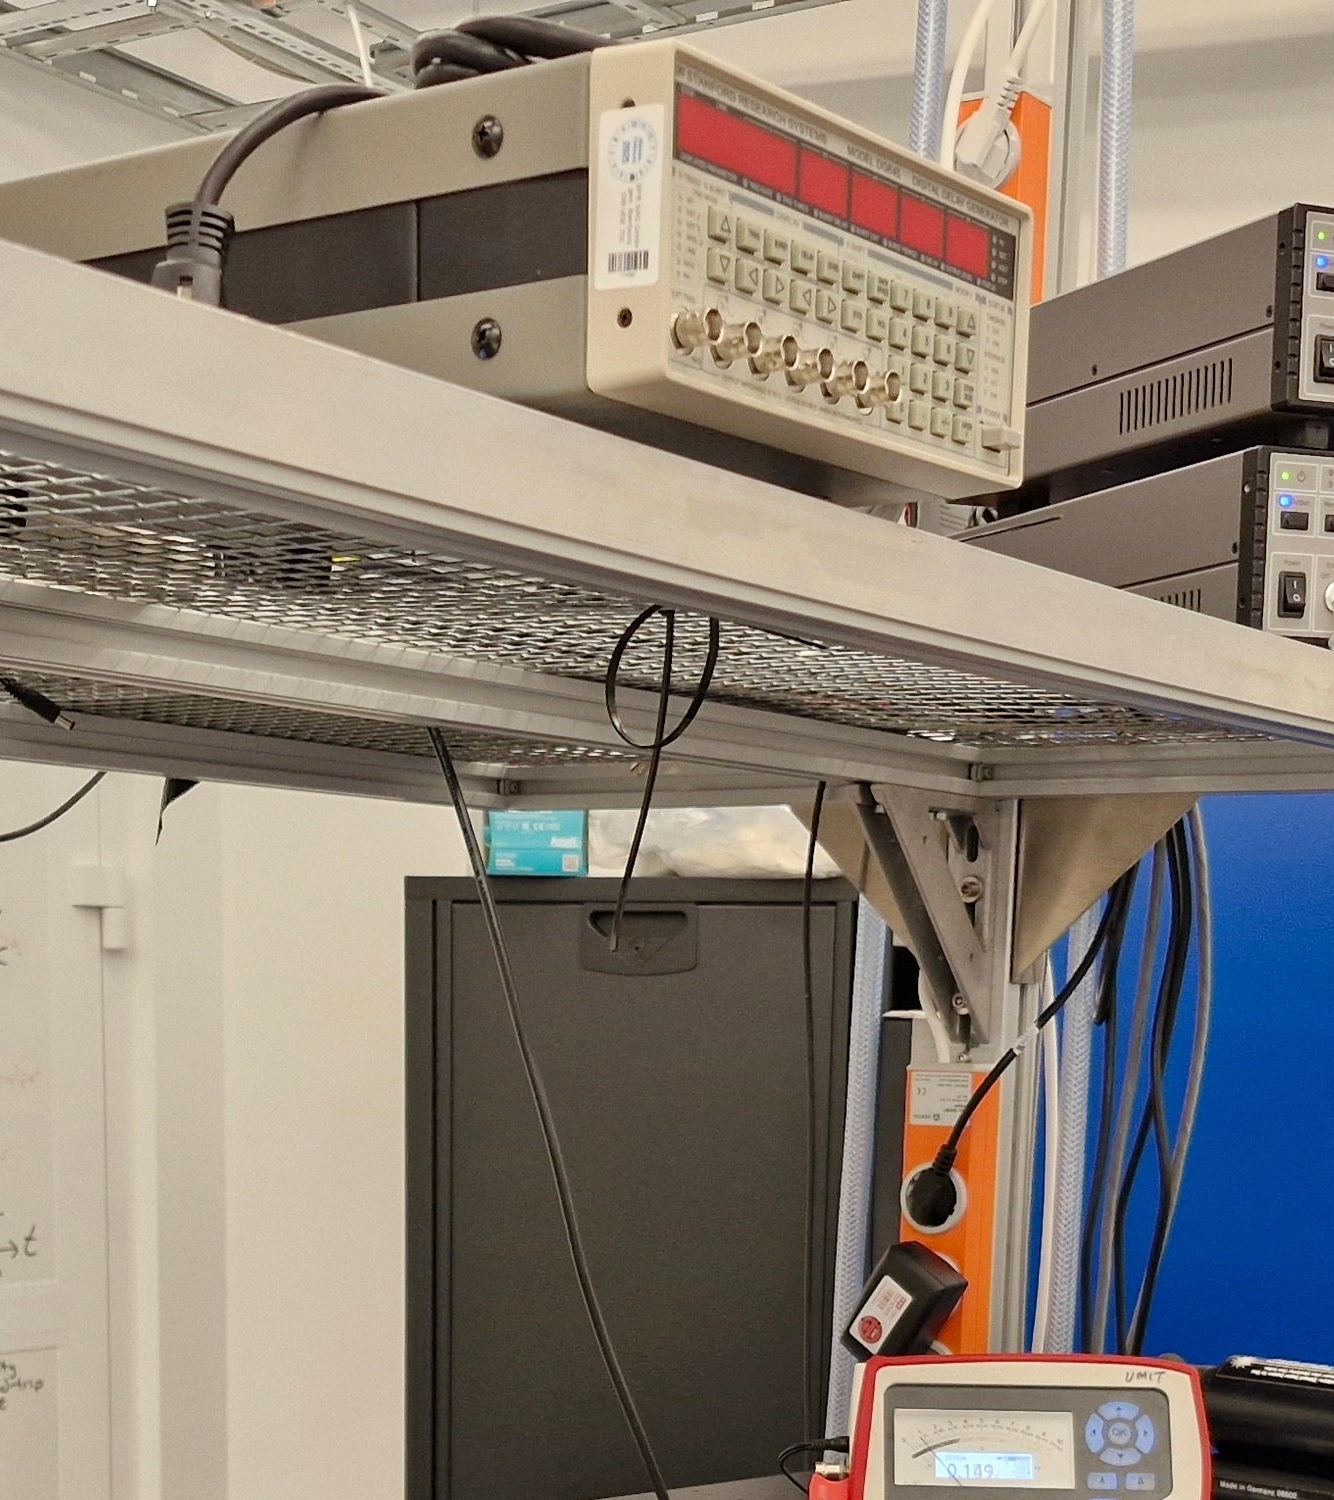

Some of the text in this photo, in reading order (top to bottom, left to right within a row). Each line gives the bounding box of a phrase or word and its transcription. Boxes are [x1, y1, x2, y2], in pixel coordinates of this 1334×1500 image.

[22, 1225, 39, 1258] t
[1111, 1427, 1128, 1437] OK
[1219, 1480, 1238, 1490] Made
[1246, 1484, 1276, 1497] Germany
